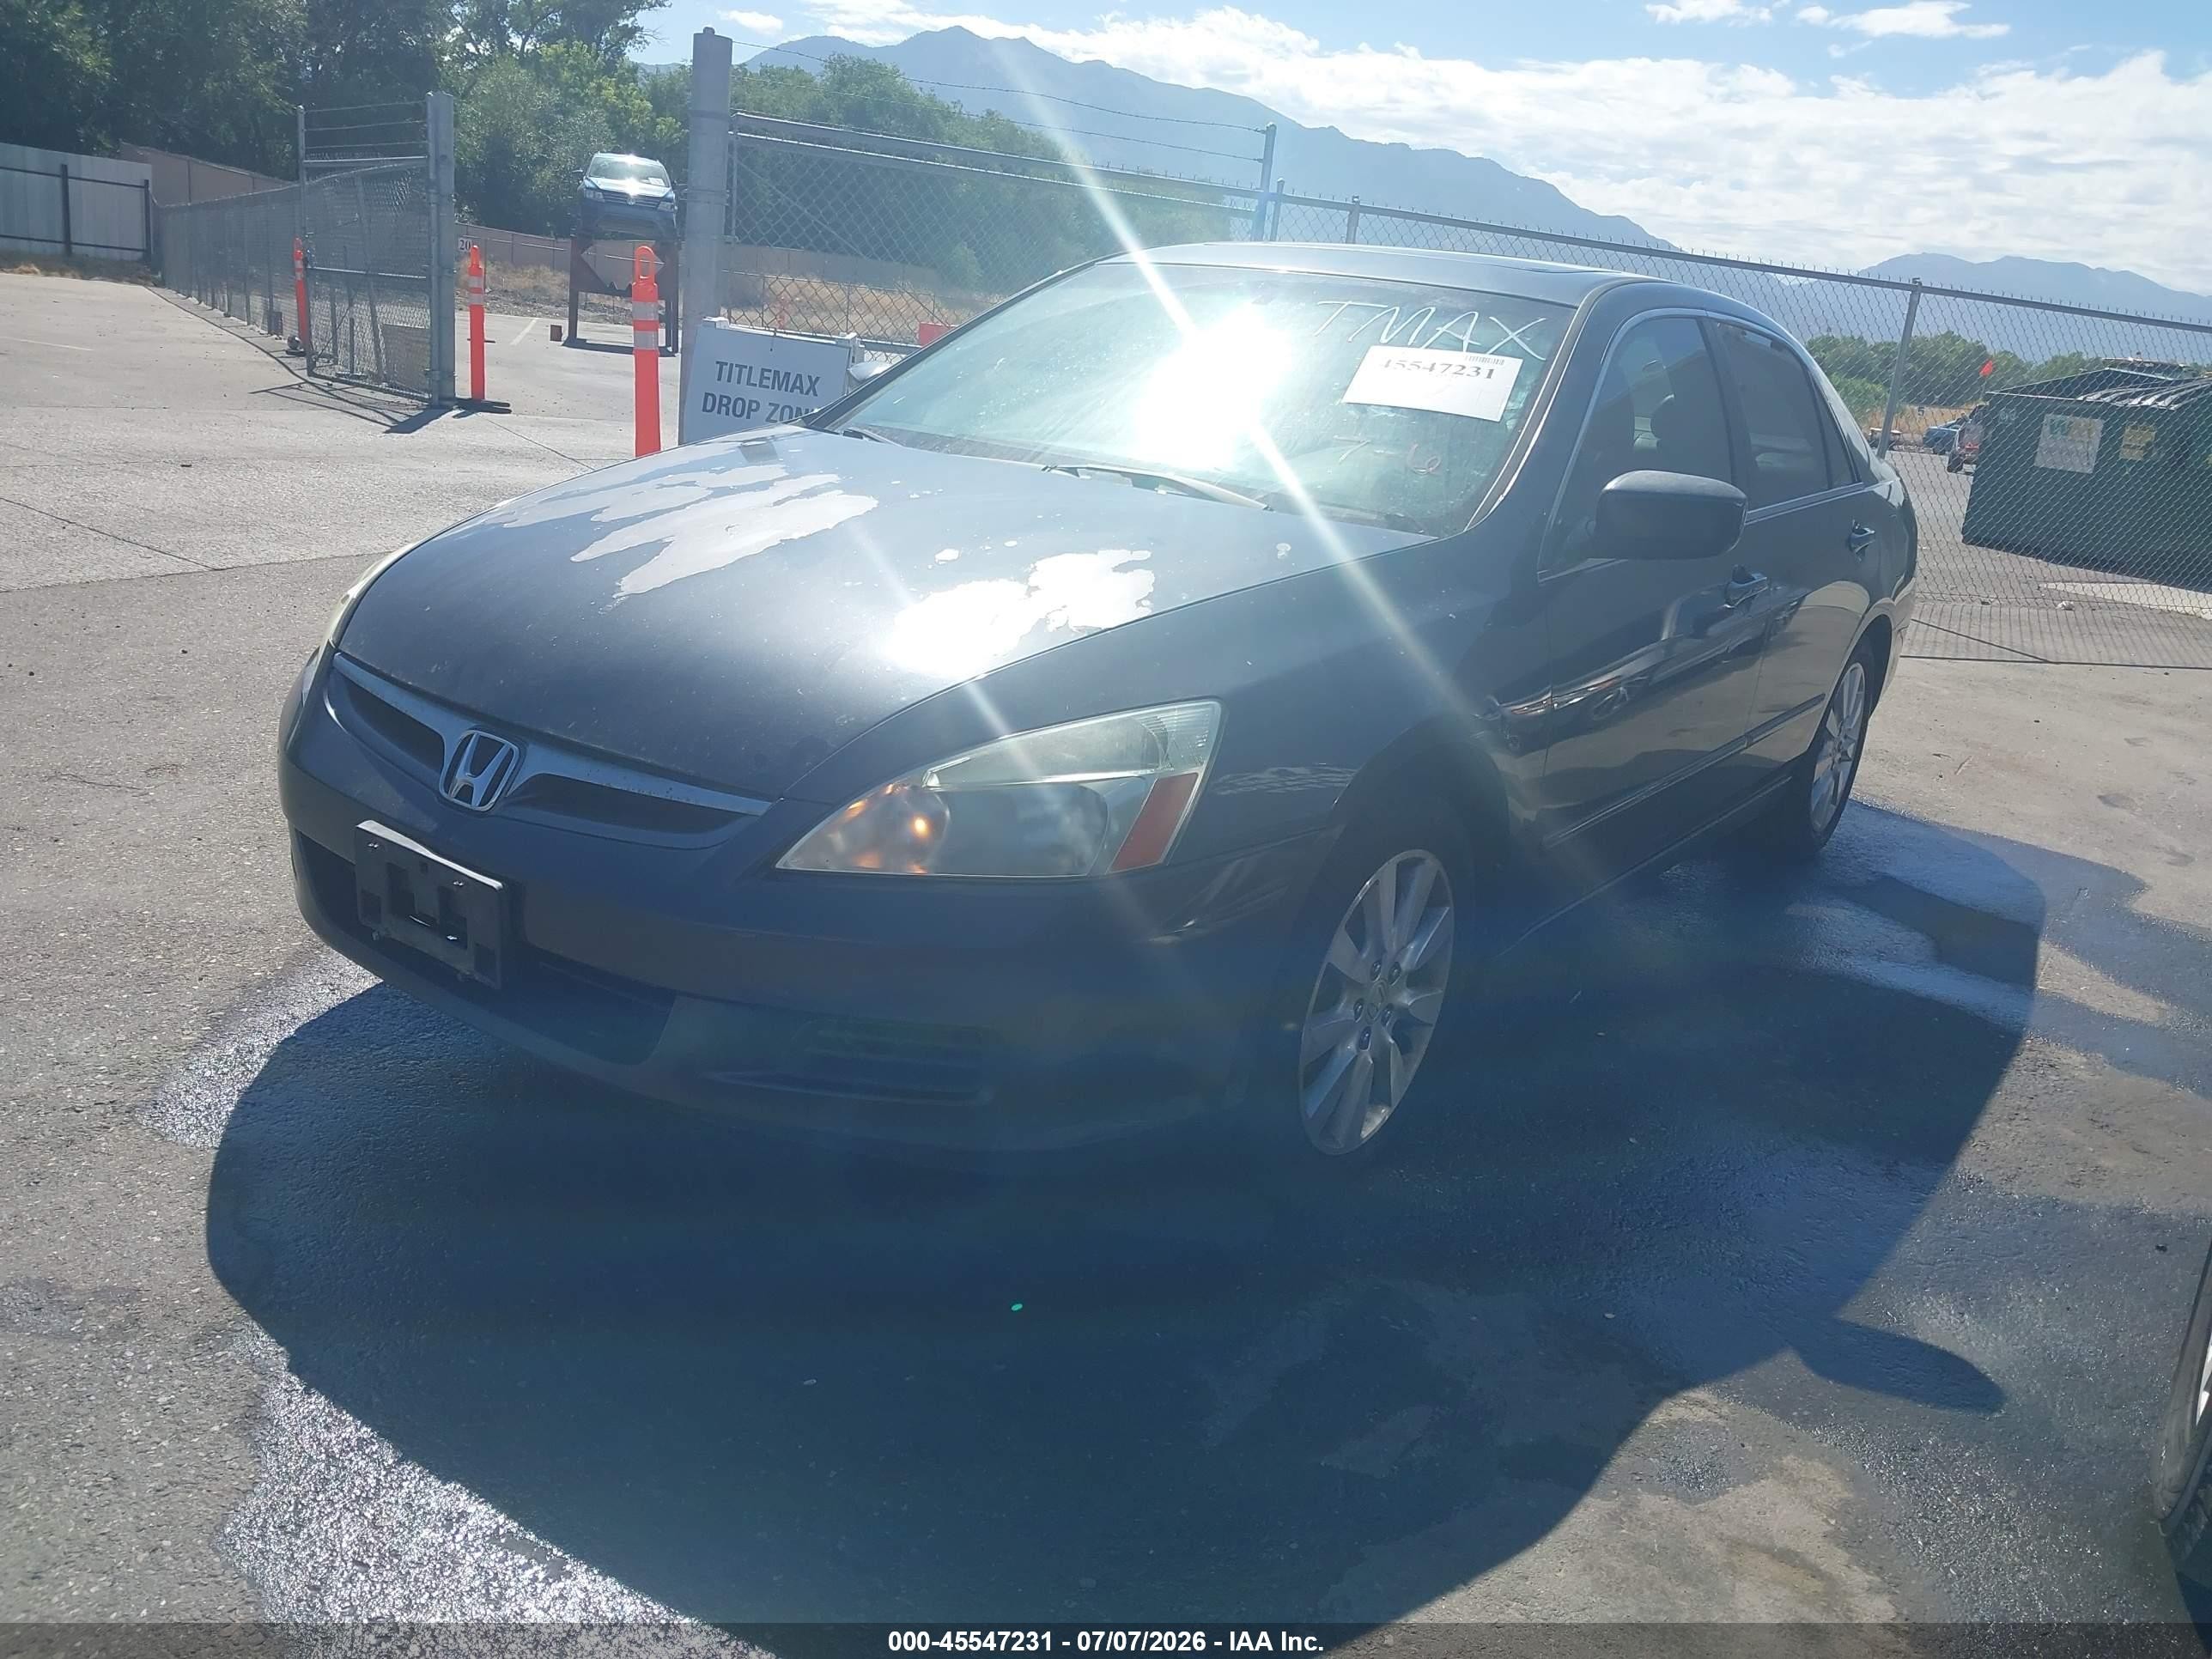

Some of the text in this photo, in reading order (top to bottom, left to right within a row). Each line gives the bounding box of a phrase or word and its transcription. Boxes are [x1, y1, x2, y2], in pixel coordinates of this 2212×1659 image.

[459, 239, 471, 251] 20
[715, 361, 820, 397] TITLEMAX
[702, 392, 815, 423] DROP ZON
